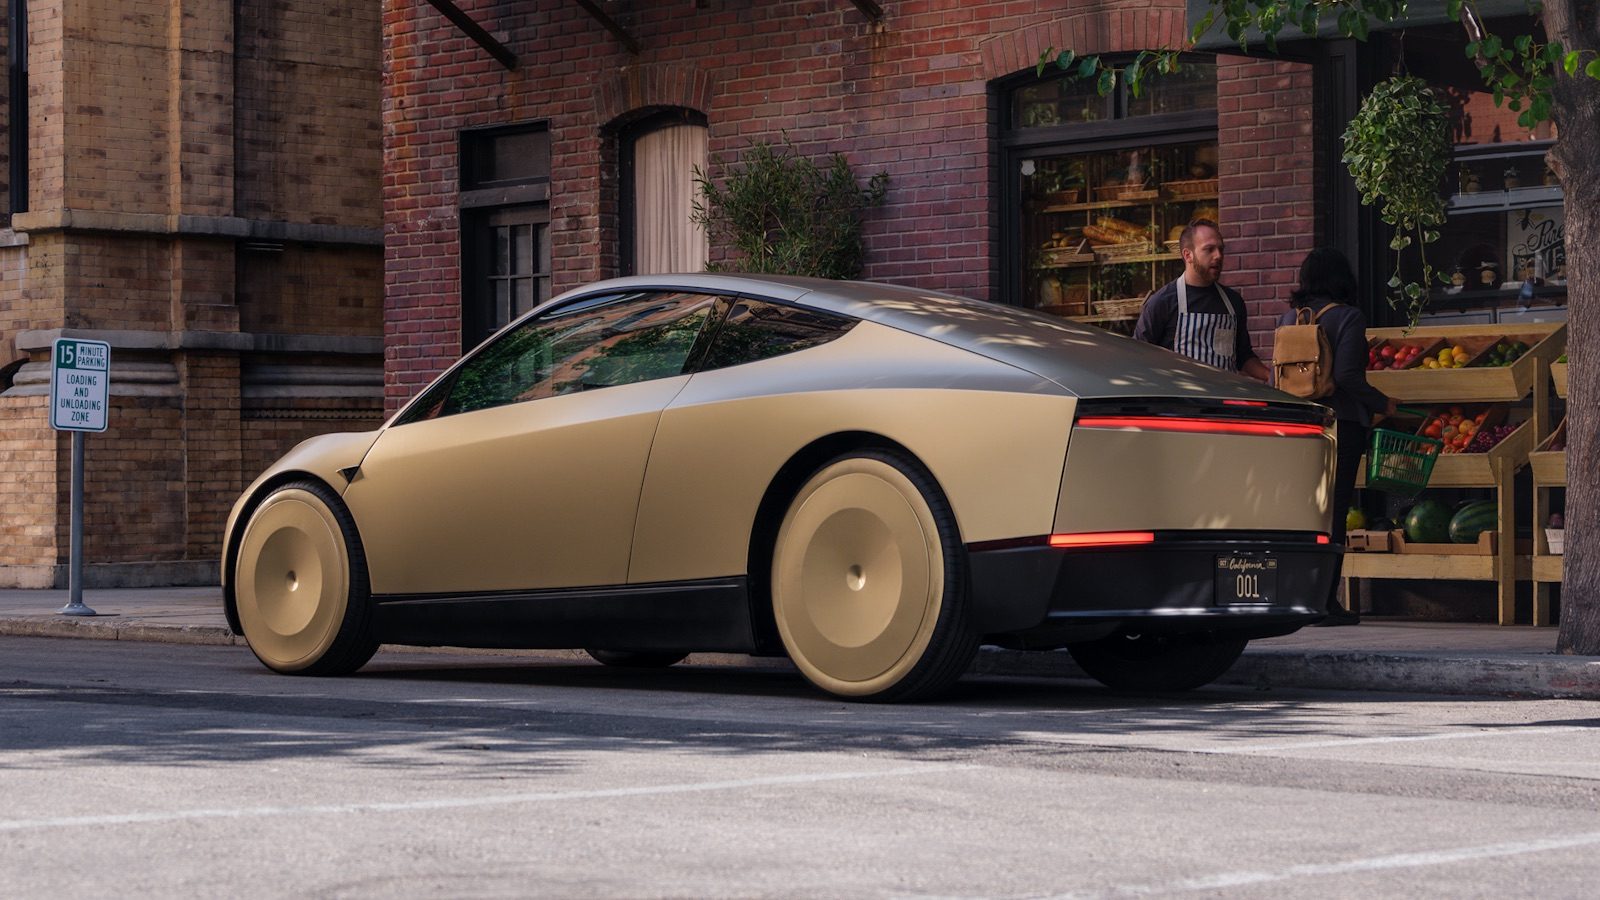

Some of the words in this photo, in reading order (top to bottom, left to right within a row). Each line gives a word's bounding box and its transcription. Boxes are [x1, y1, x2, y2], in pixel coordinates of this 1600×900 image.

[60, 344, 74, 364] 15
[80, 346, 104, 357] MINUTE
[77, 356, 105, 368] PARKING
[66, 374, 97, 386] LOADING
[74, 387, 89, 398] AND
[60, 398, 101, 411] UNLOADING
[71, 411, 90, 422] ZONE
[1229, 558, 1266, 573] California
[1236, 574, 1260, 598] 001
